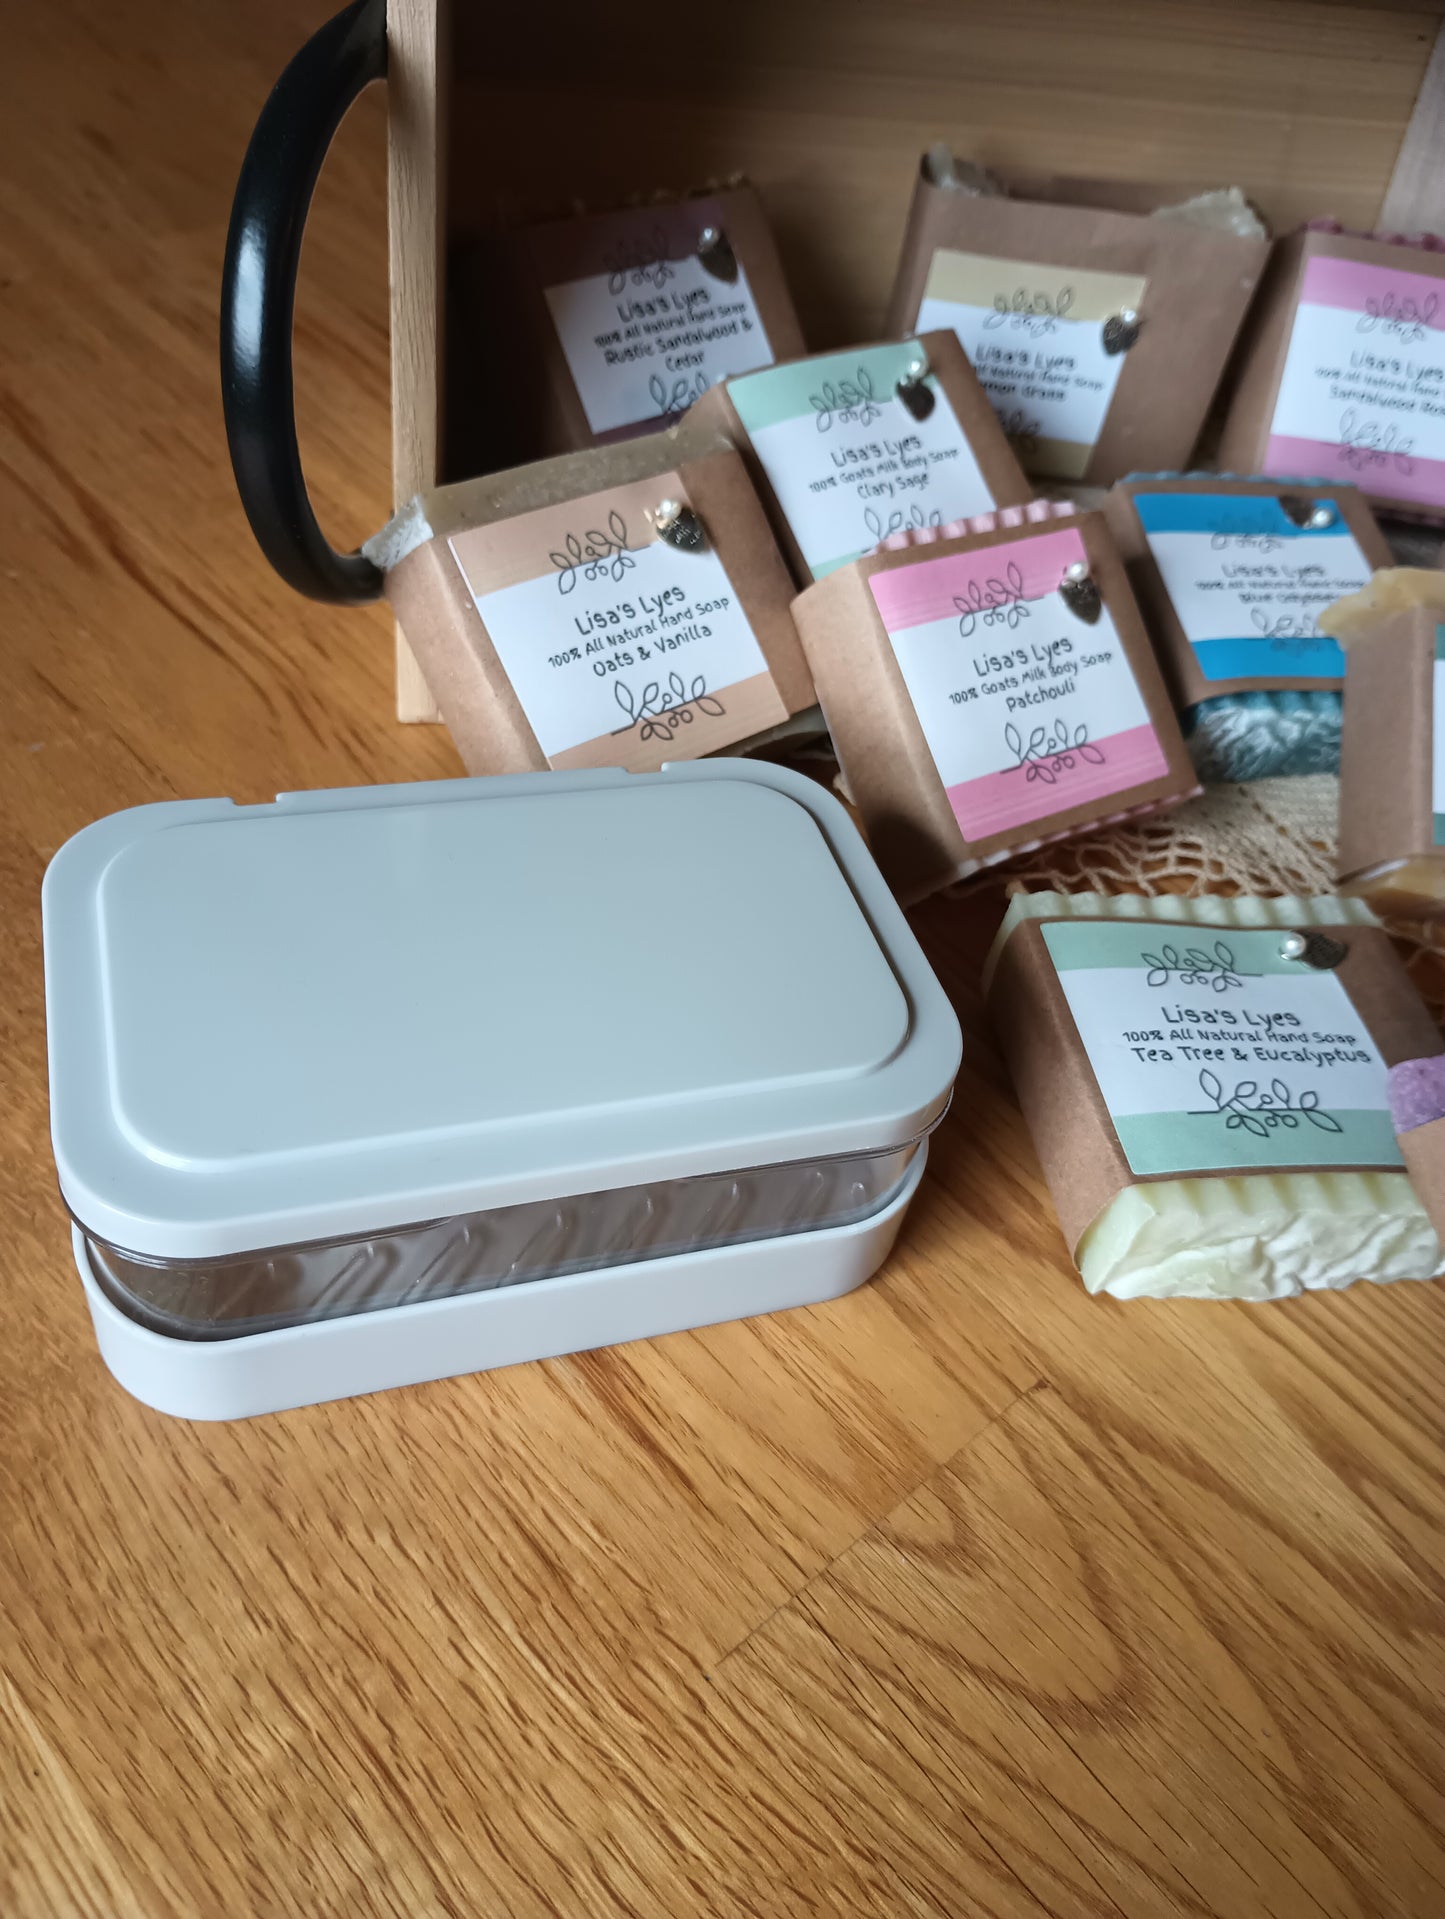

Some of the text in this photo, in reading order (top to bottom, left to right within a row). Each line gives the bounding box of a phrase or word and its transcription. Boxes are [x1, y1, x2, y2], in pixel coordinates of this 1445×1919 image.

[617, 295, 670, 323] Lisa's
[831, 434, 922, 467] Lisa's Lyes
[808, 476, 837, 493] 100%
[839, 466, 875, 484] Goats
[876, 459, 899, 475] Milk
[857, 472, 929, 499] Clary Sage
[574, 586, 686, 636] Lisa's Lyes
[548, 597, 731, 668] 100% All Natural Hand Soap
[593, 624, 713, 677] Oats & Vanilla
[972, 637, 1073, 678] Lisa's Lyes
[948, 651, 1113, 705] 100% Goats Milk Body Soap
[1161, 1004, 1301, 1032] Lisa's Lyes
[1122, 1028, 1357, 1047] 100% All Natural Hand Soap
[1131, 1045, 1372, 1068] Tea Tree & Eucalyptus
